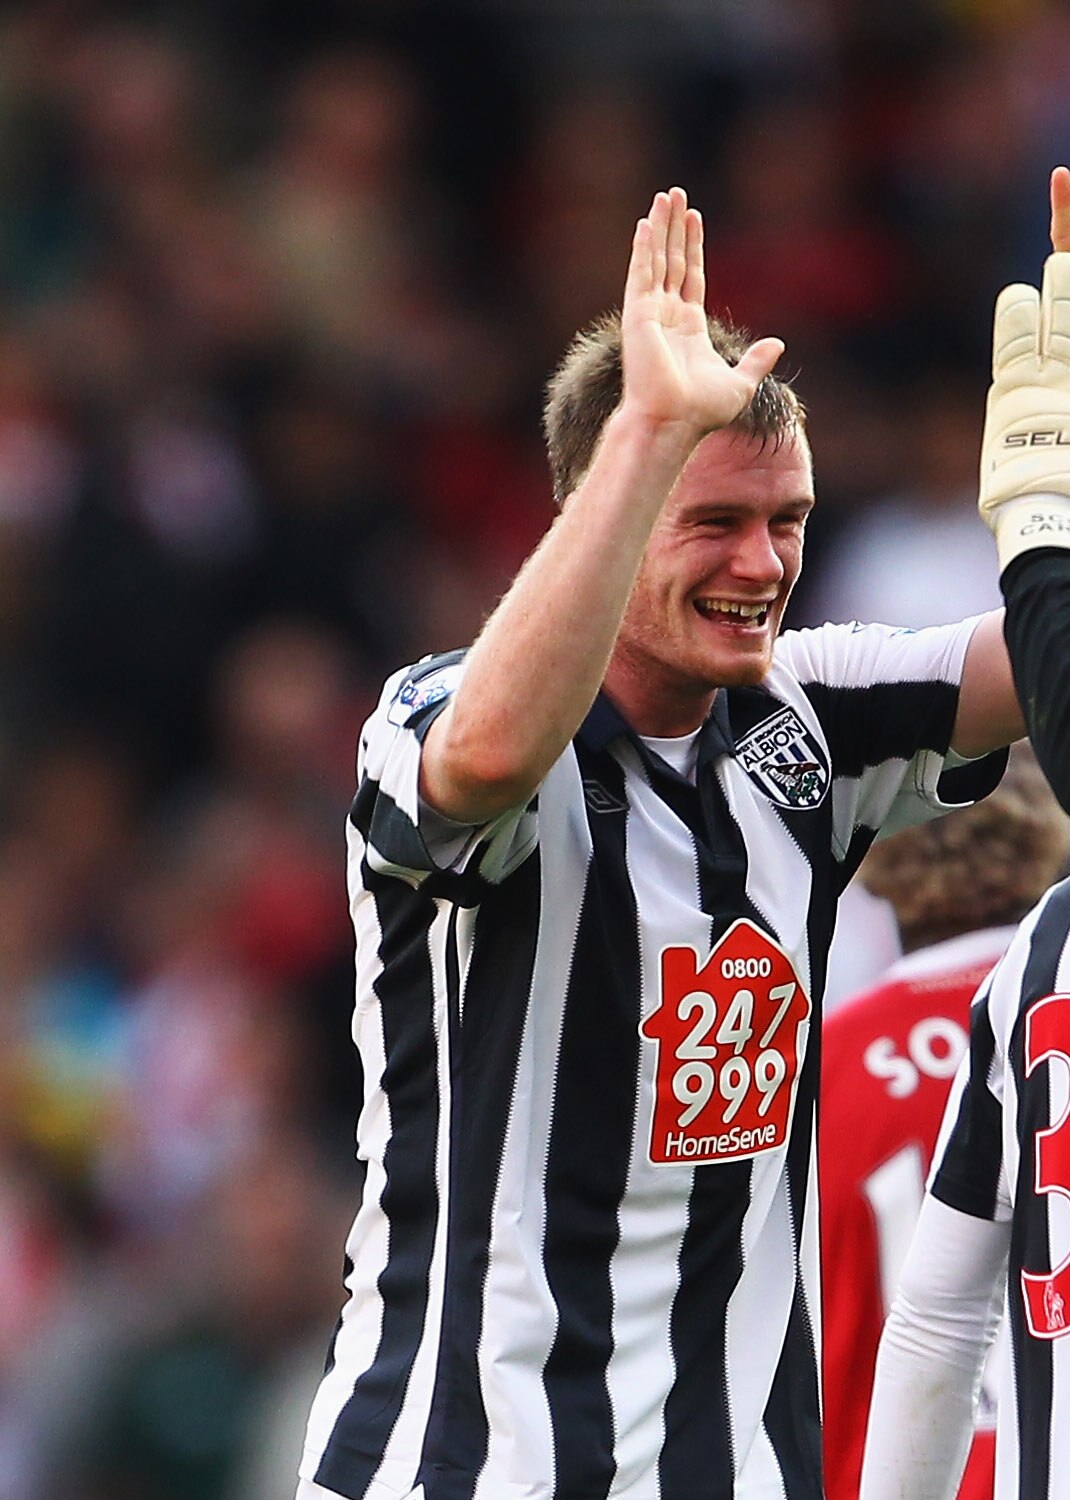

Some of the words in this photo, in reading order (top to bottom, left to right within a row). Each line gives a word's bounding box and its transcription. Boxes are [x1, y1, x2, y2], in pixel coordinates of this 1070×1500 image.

[743, 721, 804, 769] ALBION
[721, 957, 772, 979] 0800
[674, 981, 796, 1061] 247
[672, 1048, 787, 1128] 999
[665, 1124, 776, 1157] HomeServe
